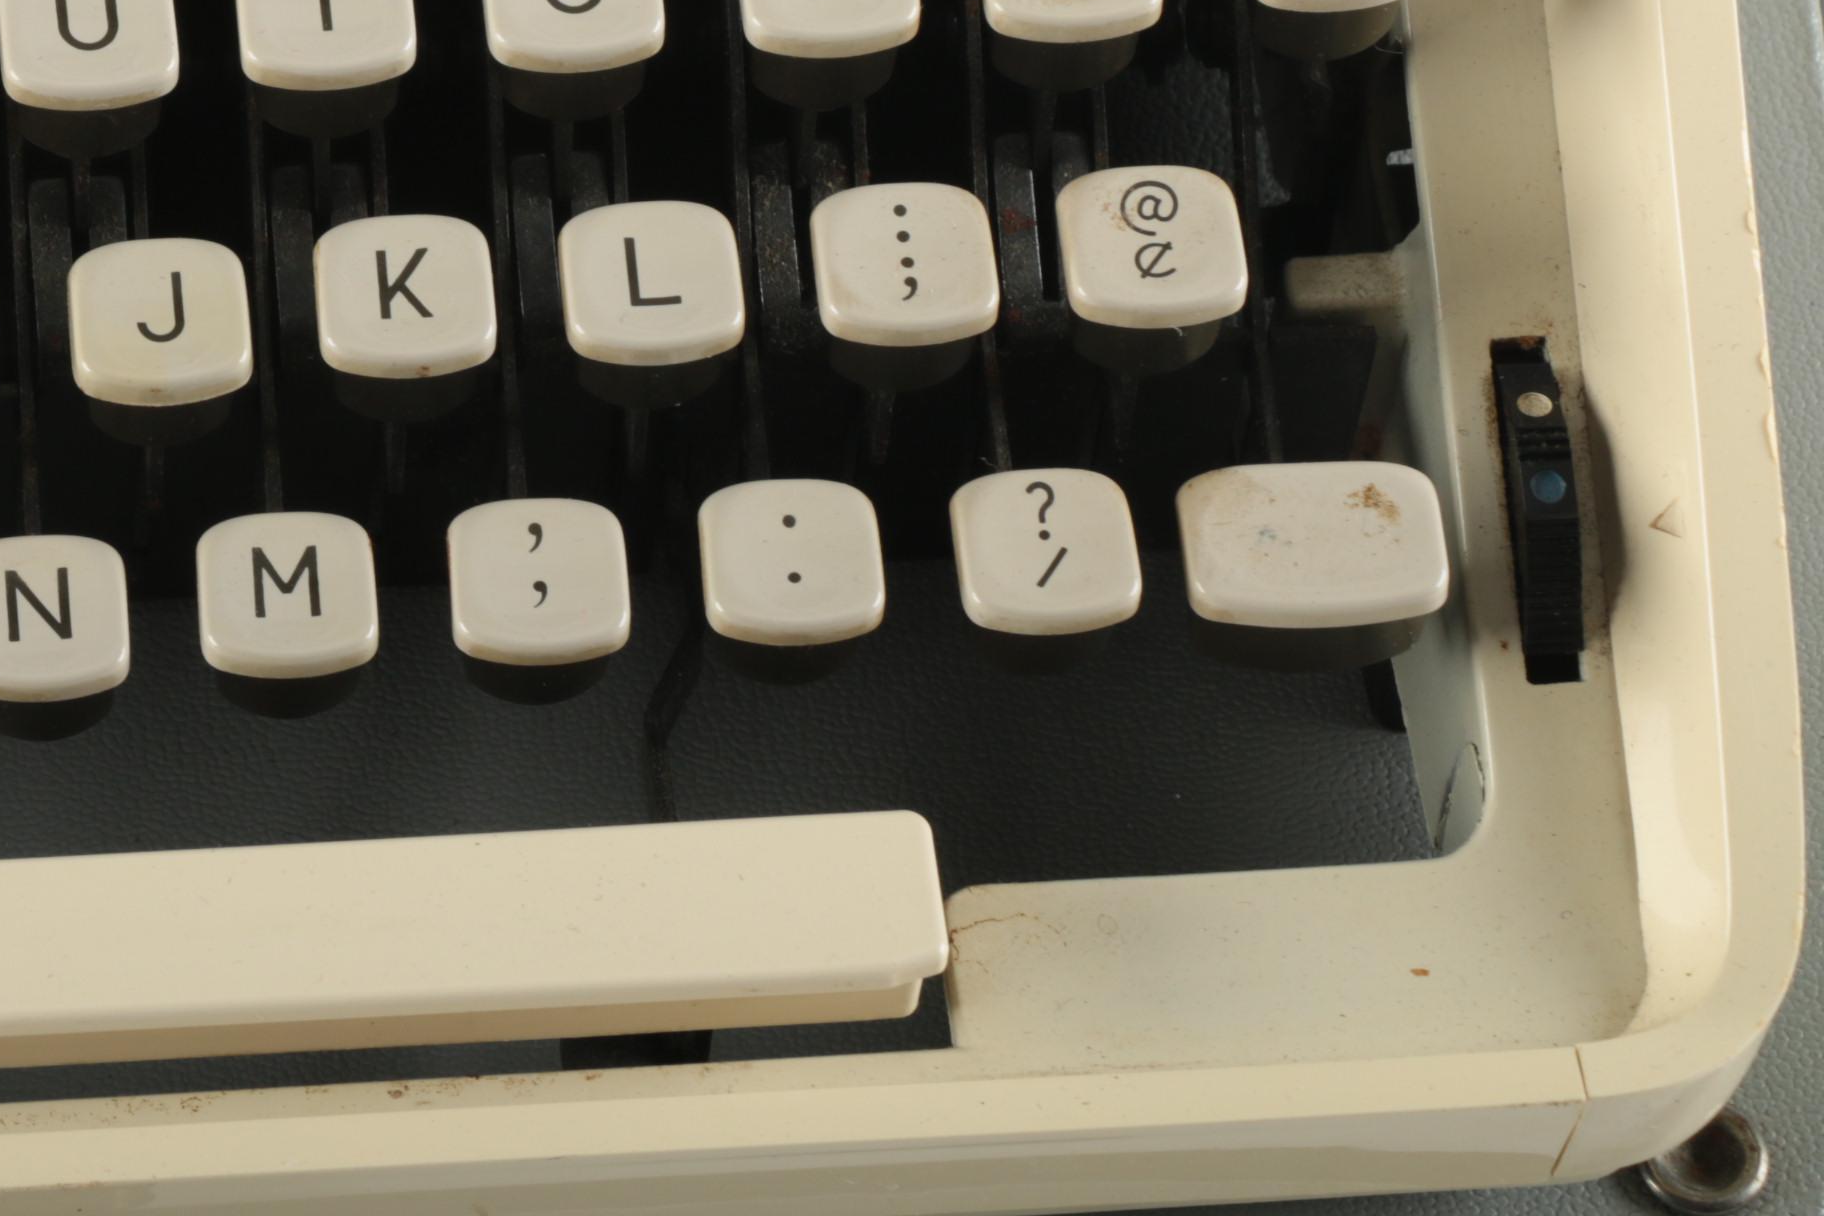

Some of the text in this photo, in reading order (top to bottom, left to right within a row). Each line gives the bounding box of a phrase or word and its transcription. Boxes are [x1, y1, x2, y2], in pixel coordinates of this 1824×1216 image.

[1119, 180, 1179, 237] @
[136, 271, 186, 343] J
[375, 247, 433, 320] K
[623, 237, 682, 307] L
[1025, 481, 1055, 541] ?
[4, 566, 73, 643] N
[251, 545, 322, 619] M
